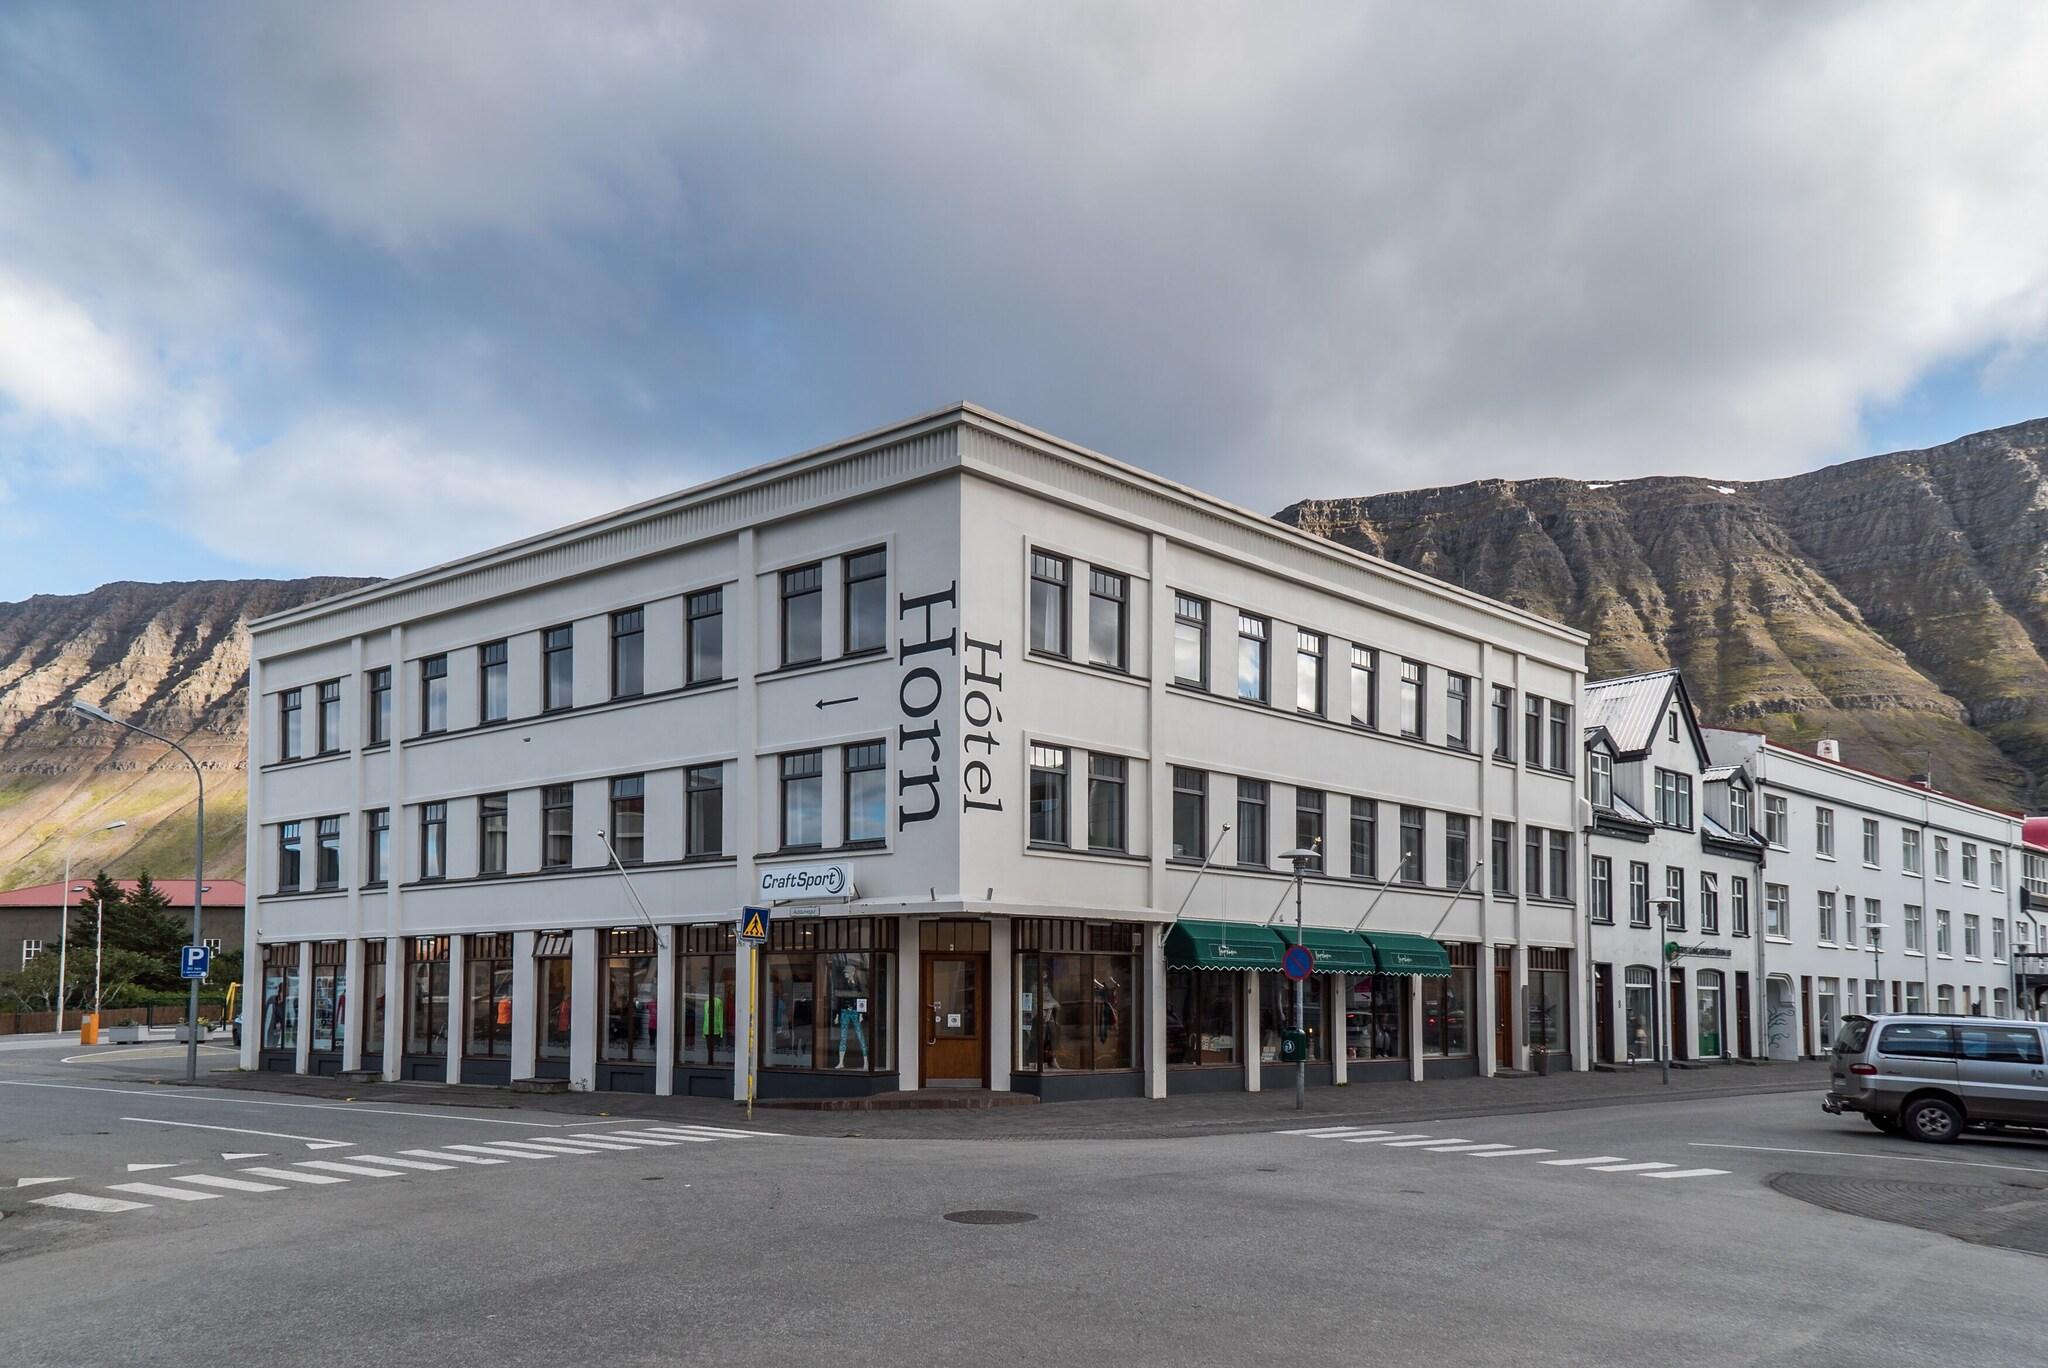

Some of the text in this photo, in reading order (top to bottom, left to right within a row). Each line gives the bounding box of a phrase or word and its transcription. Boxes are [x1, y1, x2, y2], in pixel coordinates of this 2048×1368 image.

[899, 580, 957, 832] Horn
[964, 632, 1003, 813] Hótel
[762, 871, 836, 891] CraftSport
[188, 948, 205, 966] P
